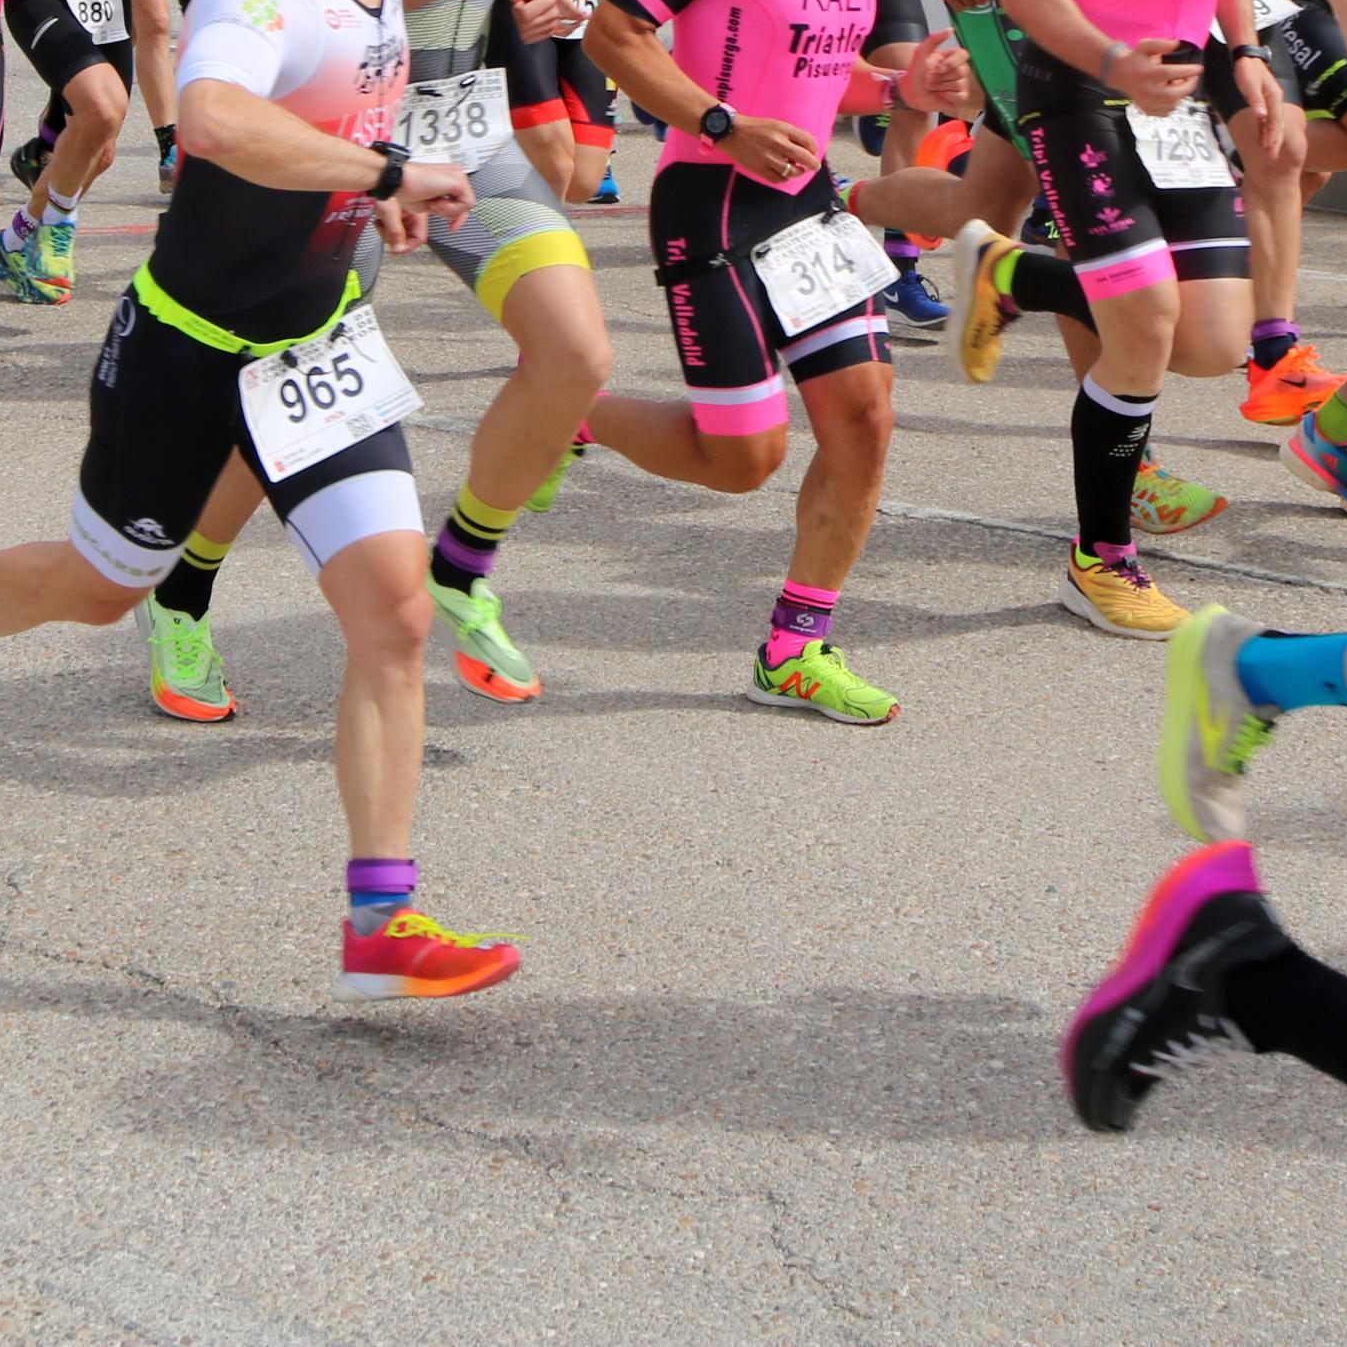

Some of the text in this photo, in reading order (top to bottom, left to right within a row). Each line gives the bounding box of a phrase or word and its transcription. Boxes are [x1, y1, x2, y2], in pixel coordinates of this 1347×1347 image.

[78, 1, 113, 23] 880
[398, 102, 489, 148] 1338
[791, 243, 857, 296] 314
[279, 352, 364, 423] 965
